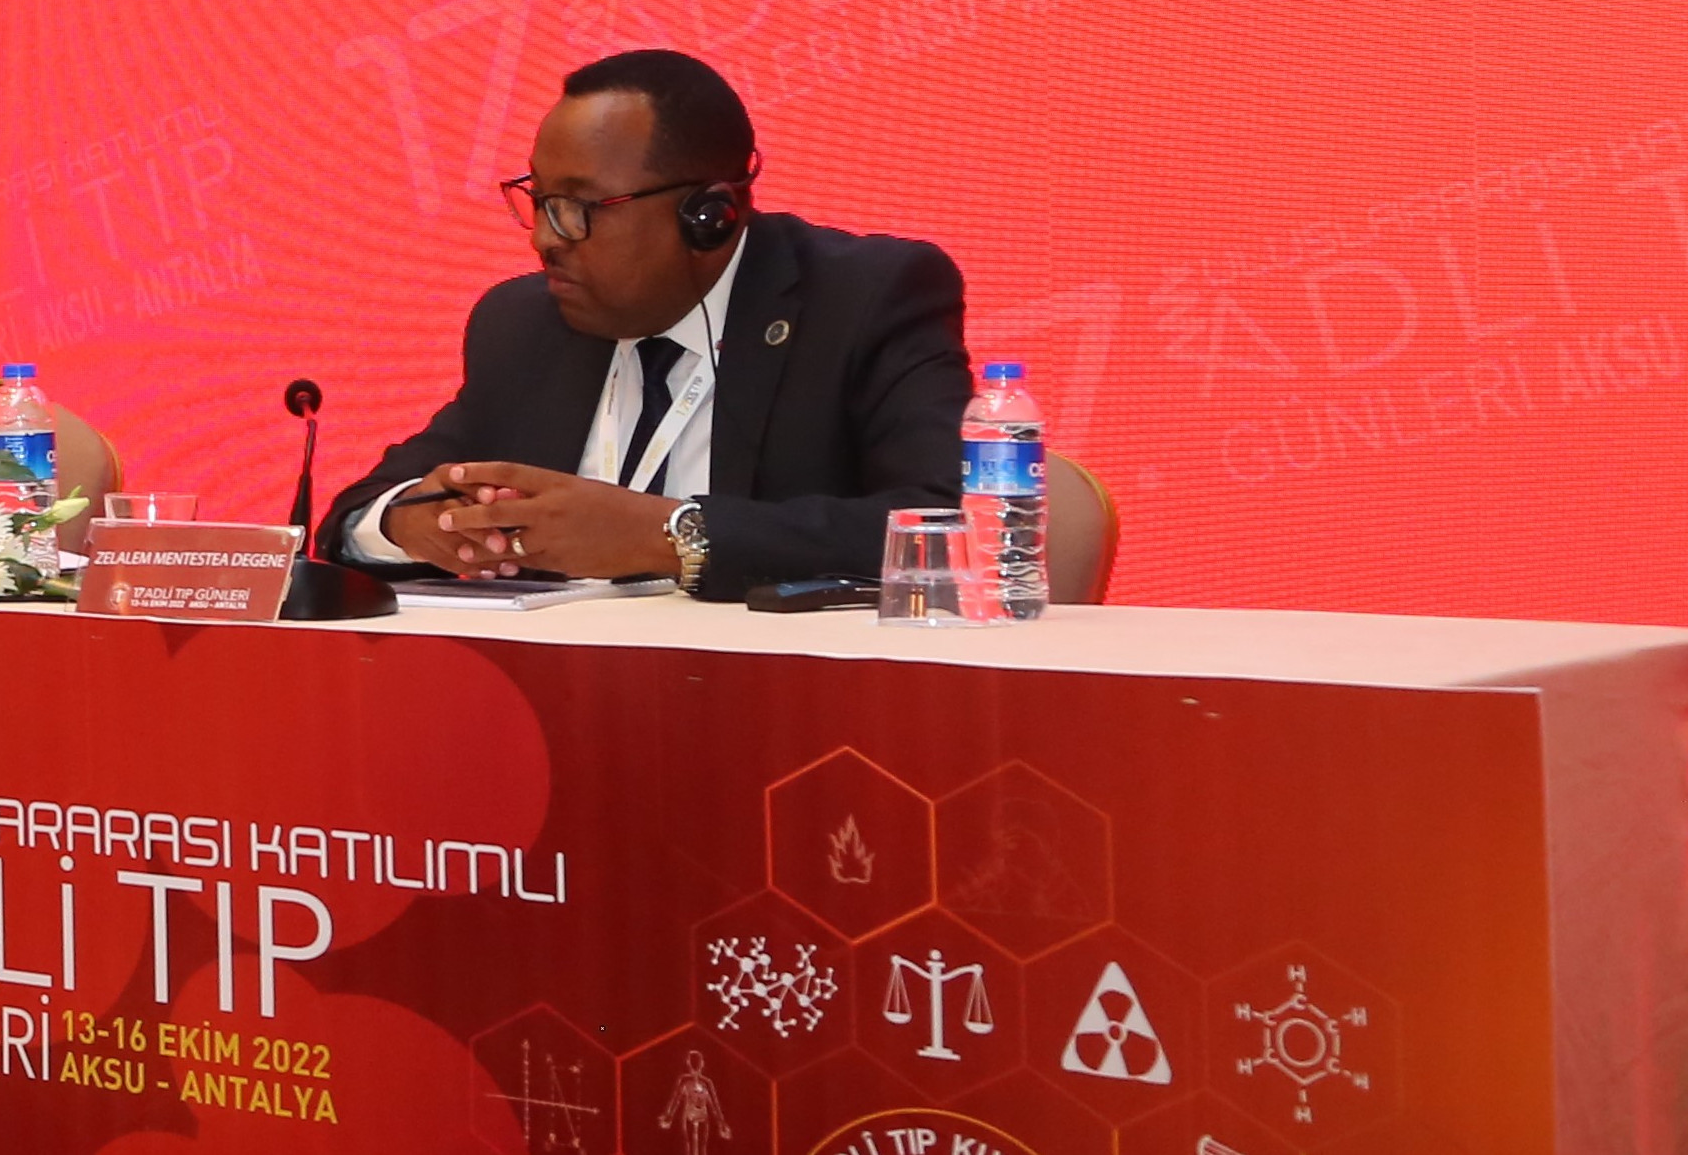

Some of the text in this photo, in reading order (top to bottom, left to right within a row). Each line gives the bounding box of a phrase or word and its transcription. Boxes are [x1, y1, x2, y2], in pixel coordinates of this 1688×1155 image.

[69, 135, 232, 261] TIP
[1221, 336, 1533, 485] GÜNLERİ
[94, 551, 287, 568] ZELALEM MENTESTEA DEGENE
[175, 587, 193, 599] TIP
[195, 588, 250, 601] GÜNLERİ
[247, 822, 567, 905] KATILIMLI
[117, 866, 334, 1020] TIP
[59, 1008, 332, 1082] 13-16 EKİM 2022
[59, 1053, 339, 1127] AKSU ANTALYA
